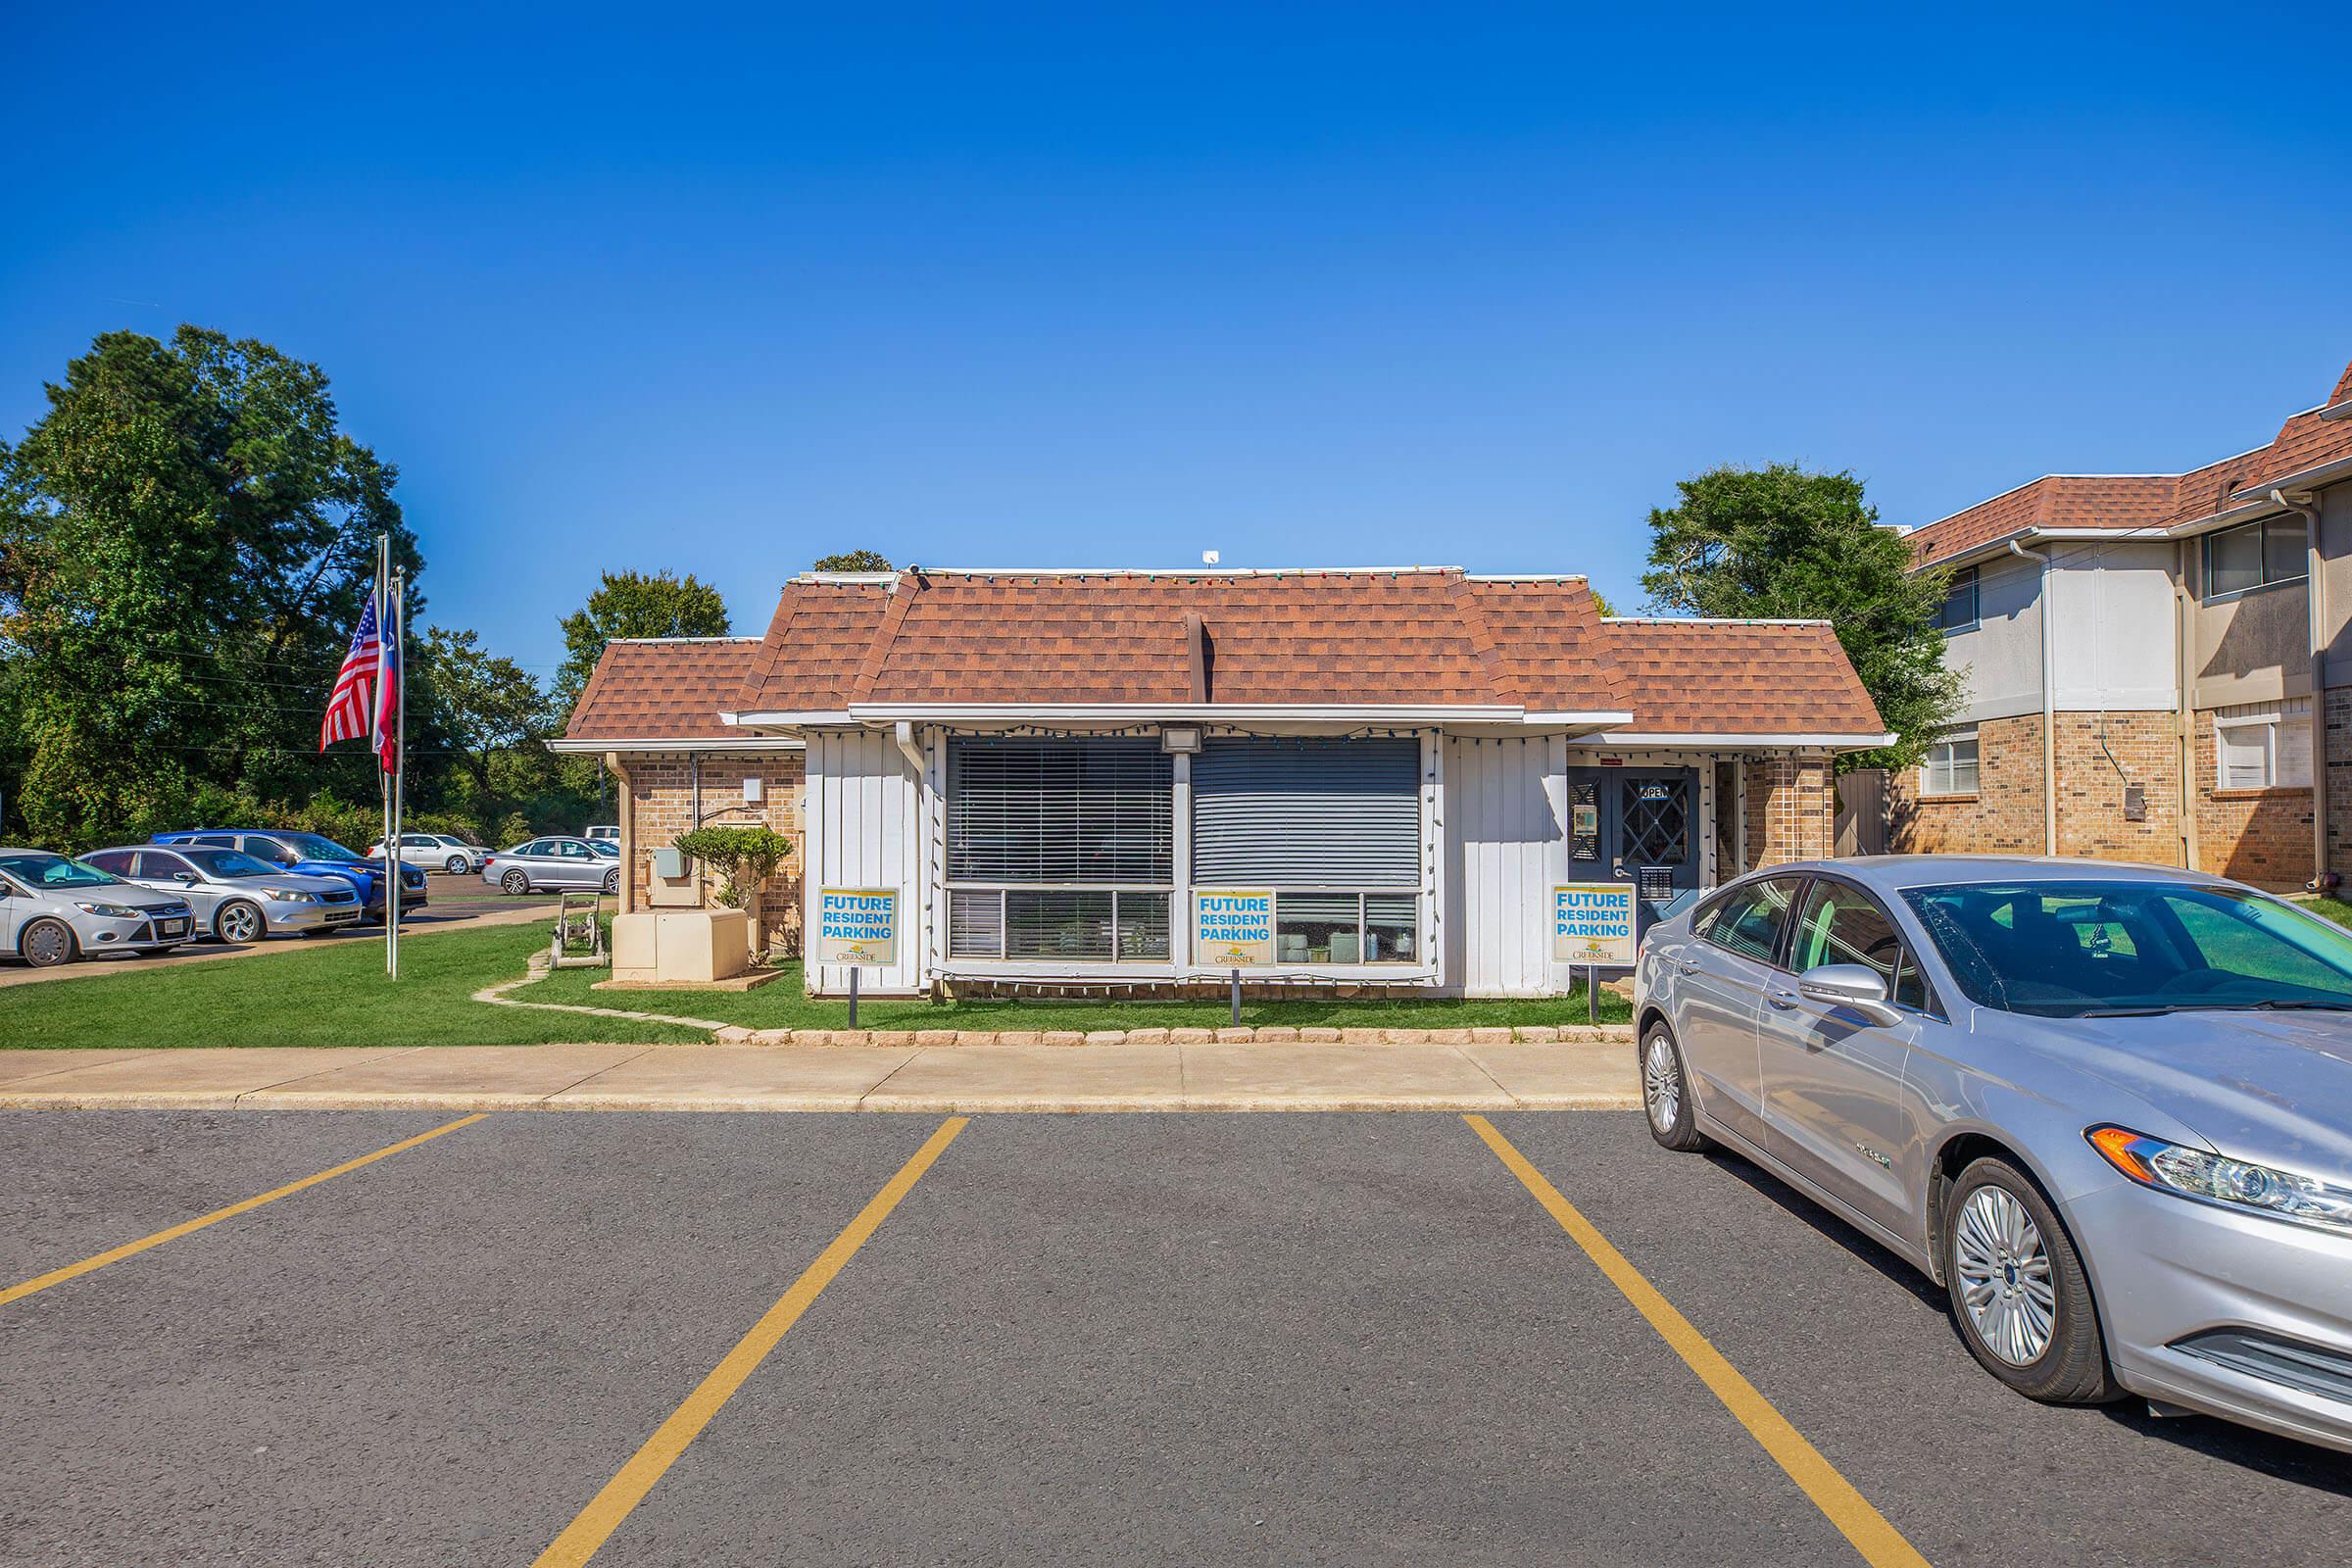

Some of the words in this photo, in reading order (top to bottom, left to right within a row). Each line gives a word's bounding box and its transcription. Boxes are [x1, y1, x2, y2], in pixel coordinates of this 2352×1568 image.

[823, 896, 893, 910] FUTURE
[1200, 898, 1269, 911] FUTURE
[1557, 893, 1629, 907] FUTURE
[823, 912, 893, 924] RESIDENT
[1200, 914, 1269, 925] RESIDENT
[1557, 909, 1629, 921] RESIDENT
[822, 926, 892, 939] PARKING
[1200, 928, 1269, 941] PARKING
[1557, 923, 1629, 937] PARKING
